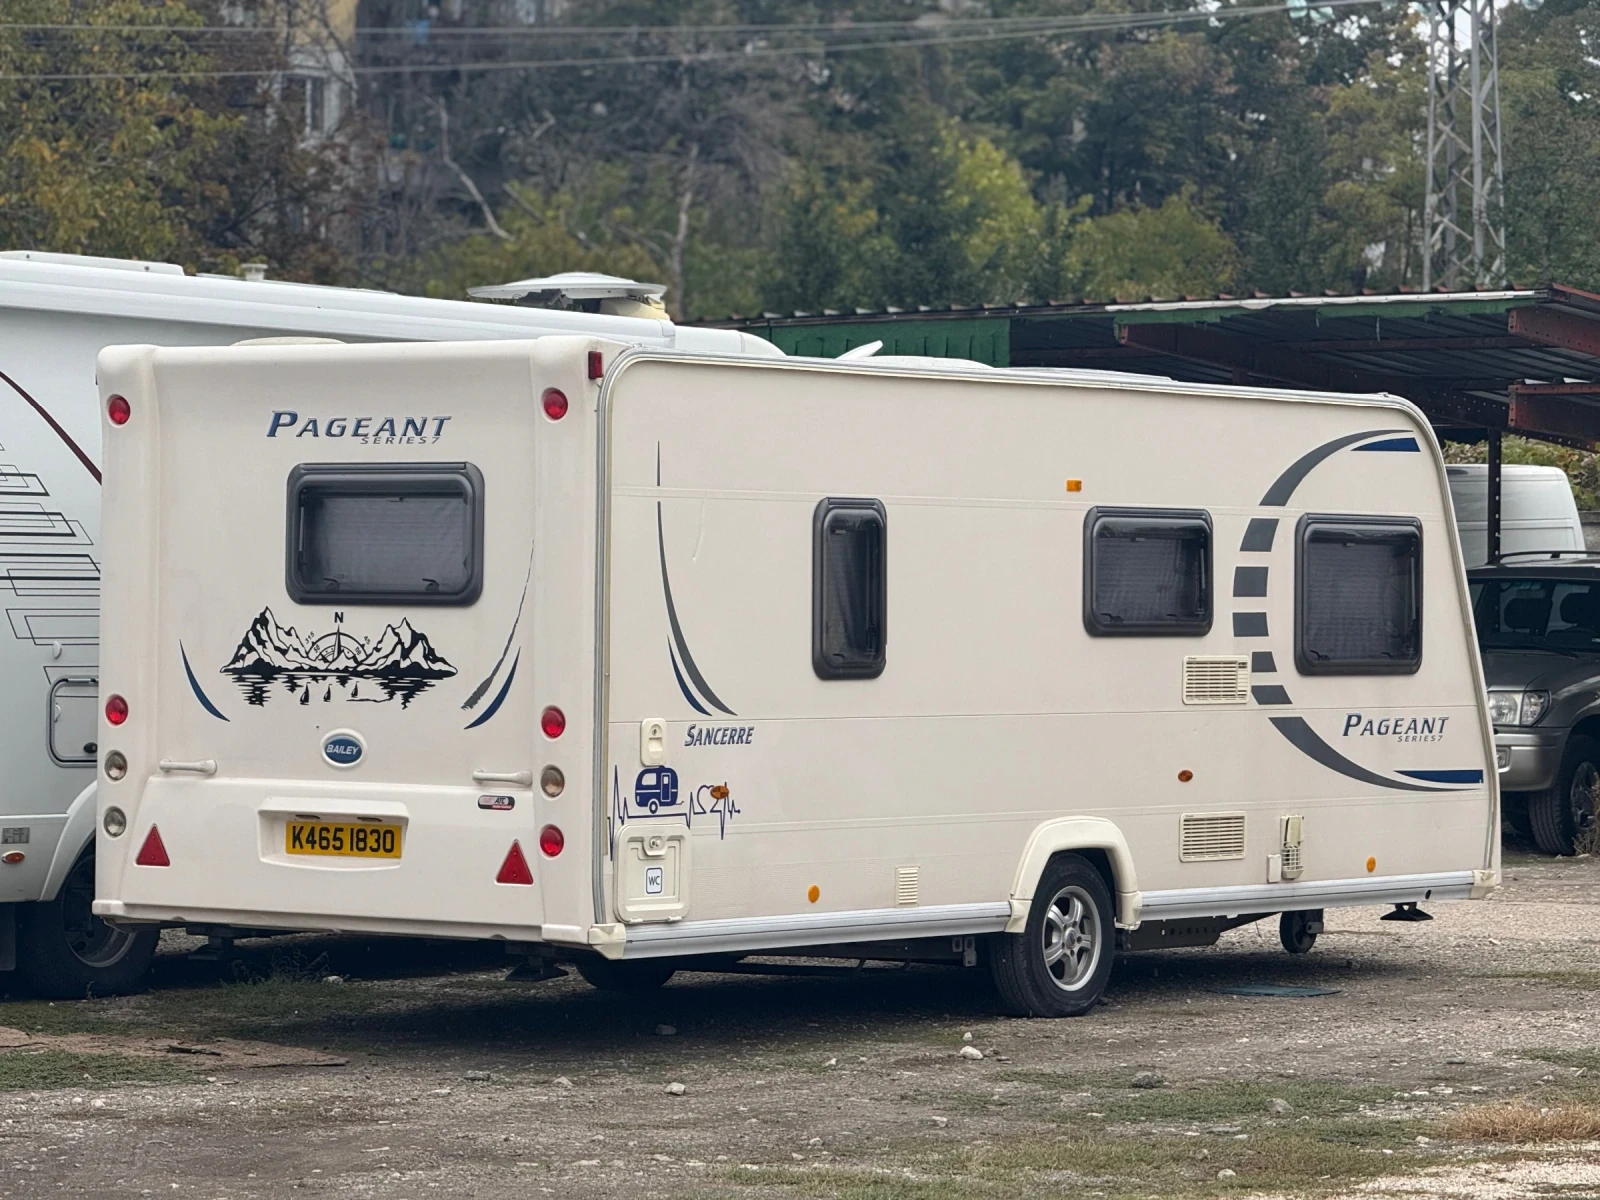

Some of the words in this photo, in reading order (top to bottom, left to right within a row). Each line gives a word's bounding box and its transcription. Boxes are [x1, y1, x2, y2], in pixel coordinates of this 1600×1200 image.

[266, 410, 452, 438] PAGEANT
[334, 611, 344, 624] N
[304, 630, 315, 645] 315
[1342, 712, 1450, 737] PAGEANT
[684, 723, 755, 747] SANCERRE
[326, 744, 359, 755] BAILEY
[648, 875, 661, 886] WC
